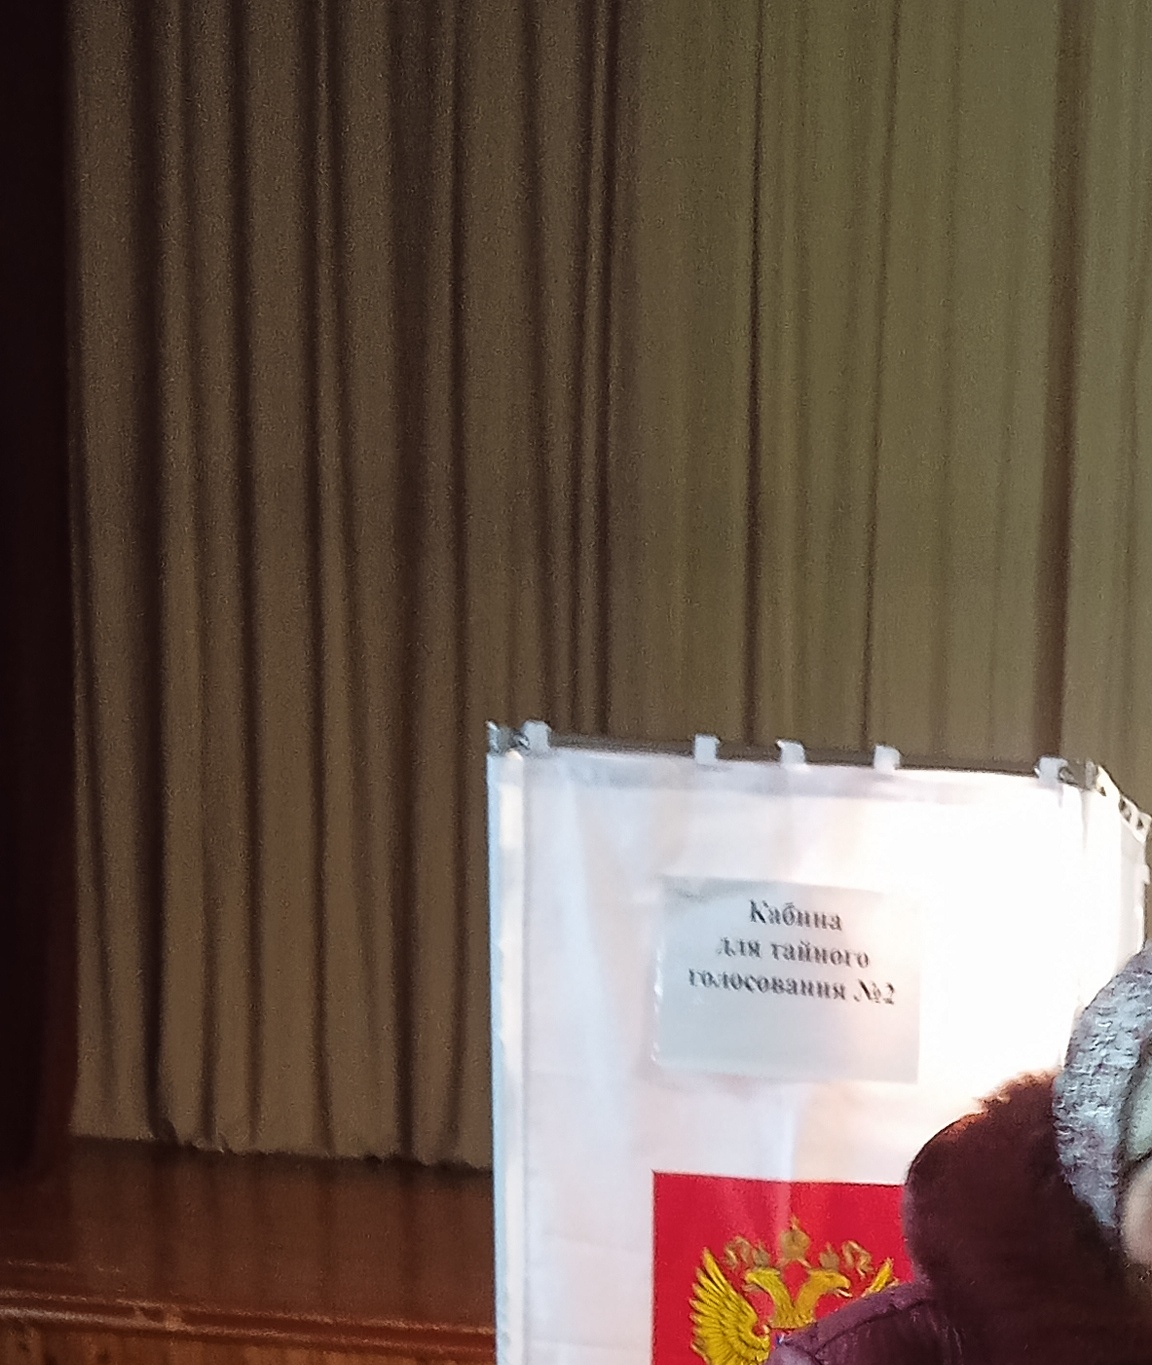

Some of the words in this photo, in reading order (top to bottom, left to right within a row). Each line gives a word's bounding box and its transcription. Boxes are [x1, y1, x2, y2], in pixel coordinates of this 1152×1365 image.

[749, 899, 843, 931] Кабина
[717, 937, 761, 958] для
[770, 940, 870, 969] тайного
[688, 967, 846, 1000] голосования
[853, 978, 895, 1005] №2
